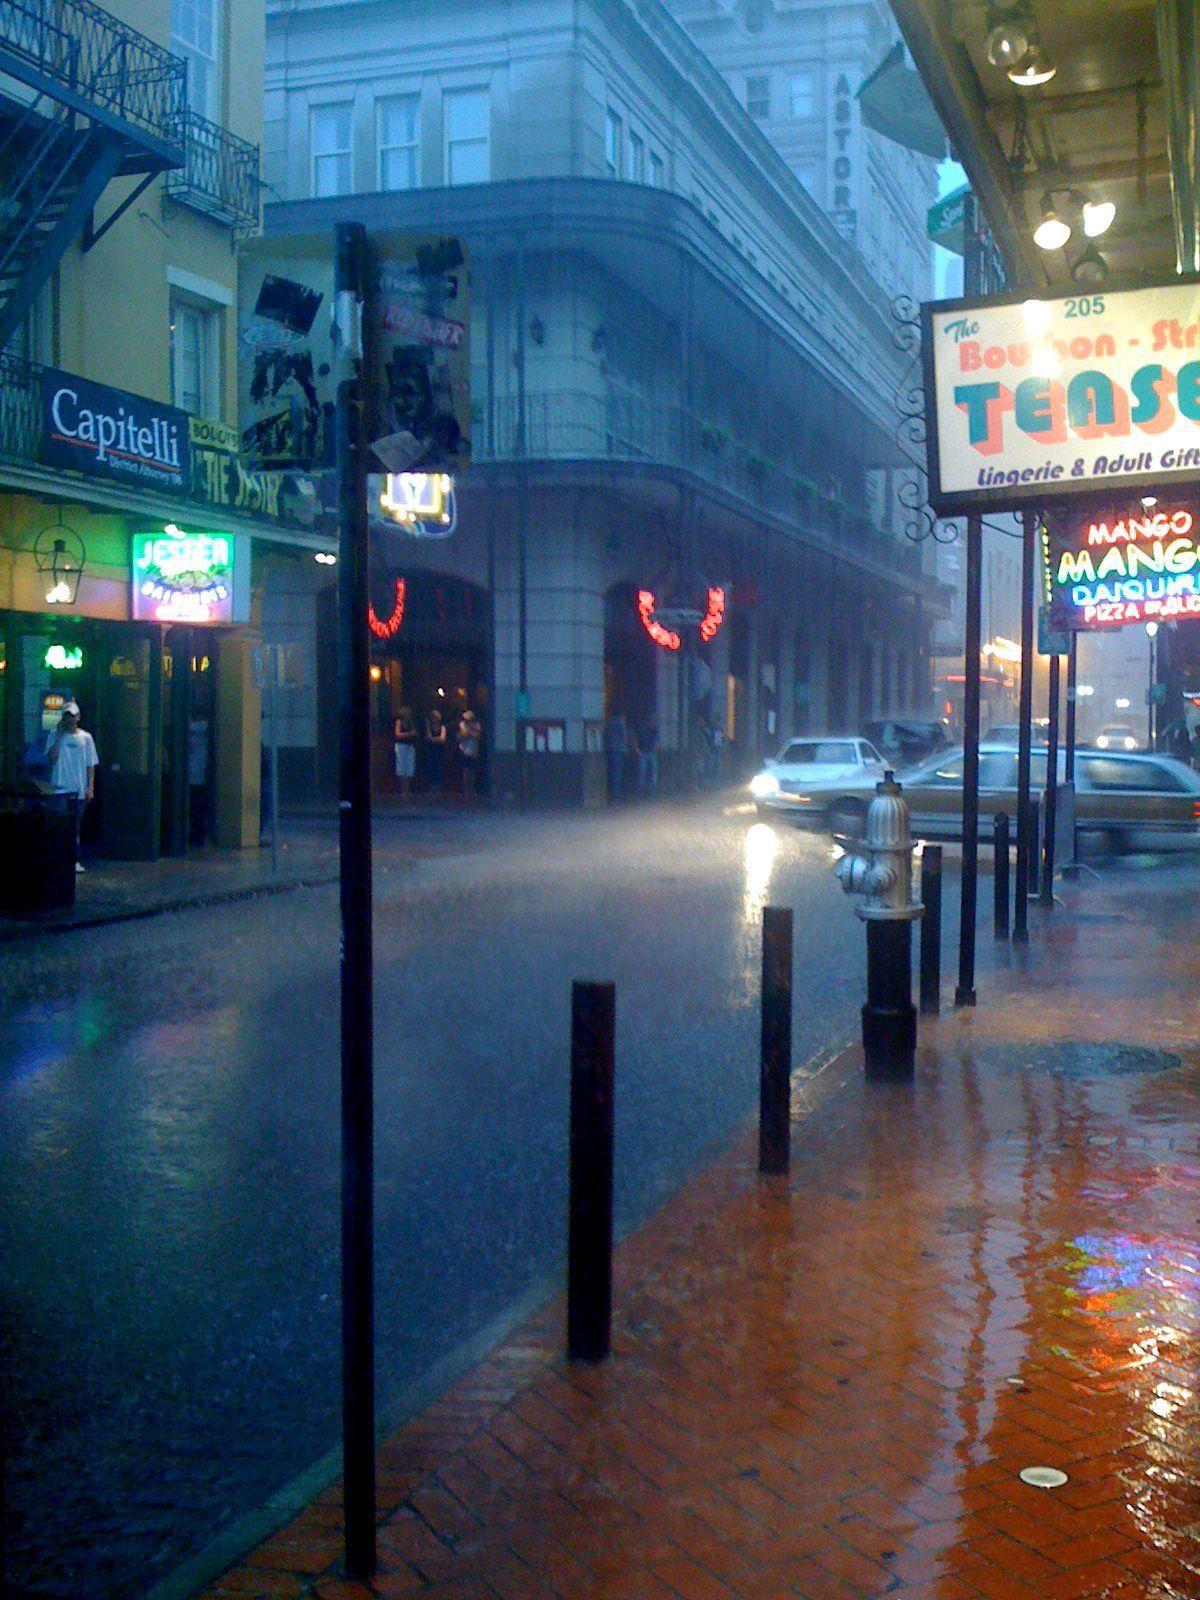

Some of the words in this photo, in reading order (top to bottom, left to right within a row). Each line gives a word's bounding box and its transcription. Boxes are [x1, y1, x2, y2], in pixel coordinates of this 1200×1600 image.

[1064, 296, 1106, 318] 205
[944, 319, 980, 343] The
[959, 332, 1116, 372] Boubon
[1152, 315, 1200, 352] Str
[52, 388, 181, 467] Capitelli
[977, 461, 1064, 487] Lingerie
[1070, 458, 1085, 478] &
[1093, 452, 1152, 475] Adult
[1160, 447, 1200, 469] Gift
[1088, 511, 1193, 545] MANGO
[1057, 538, 1200, 583] MANG
[1084, 602, 1140, 622] PIZZA
